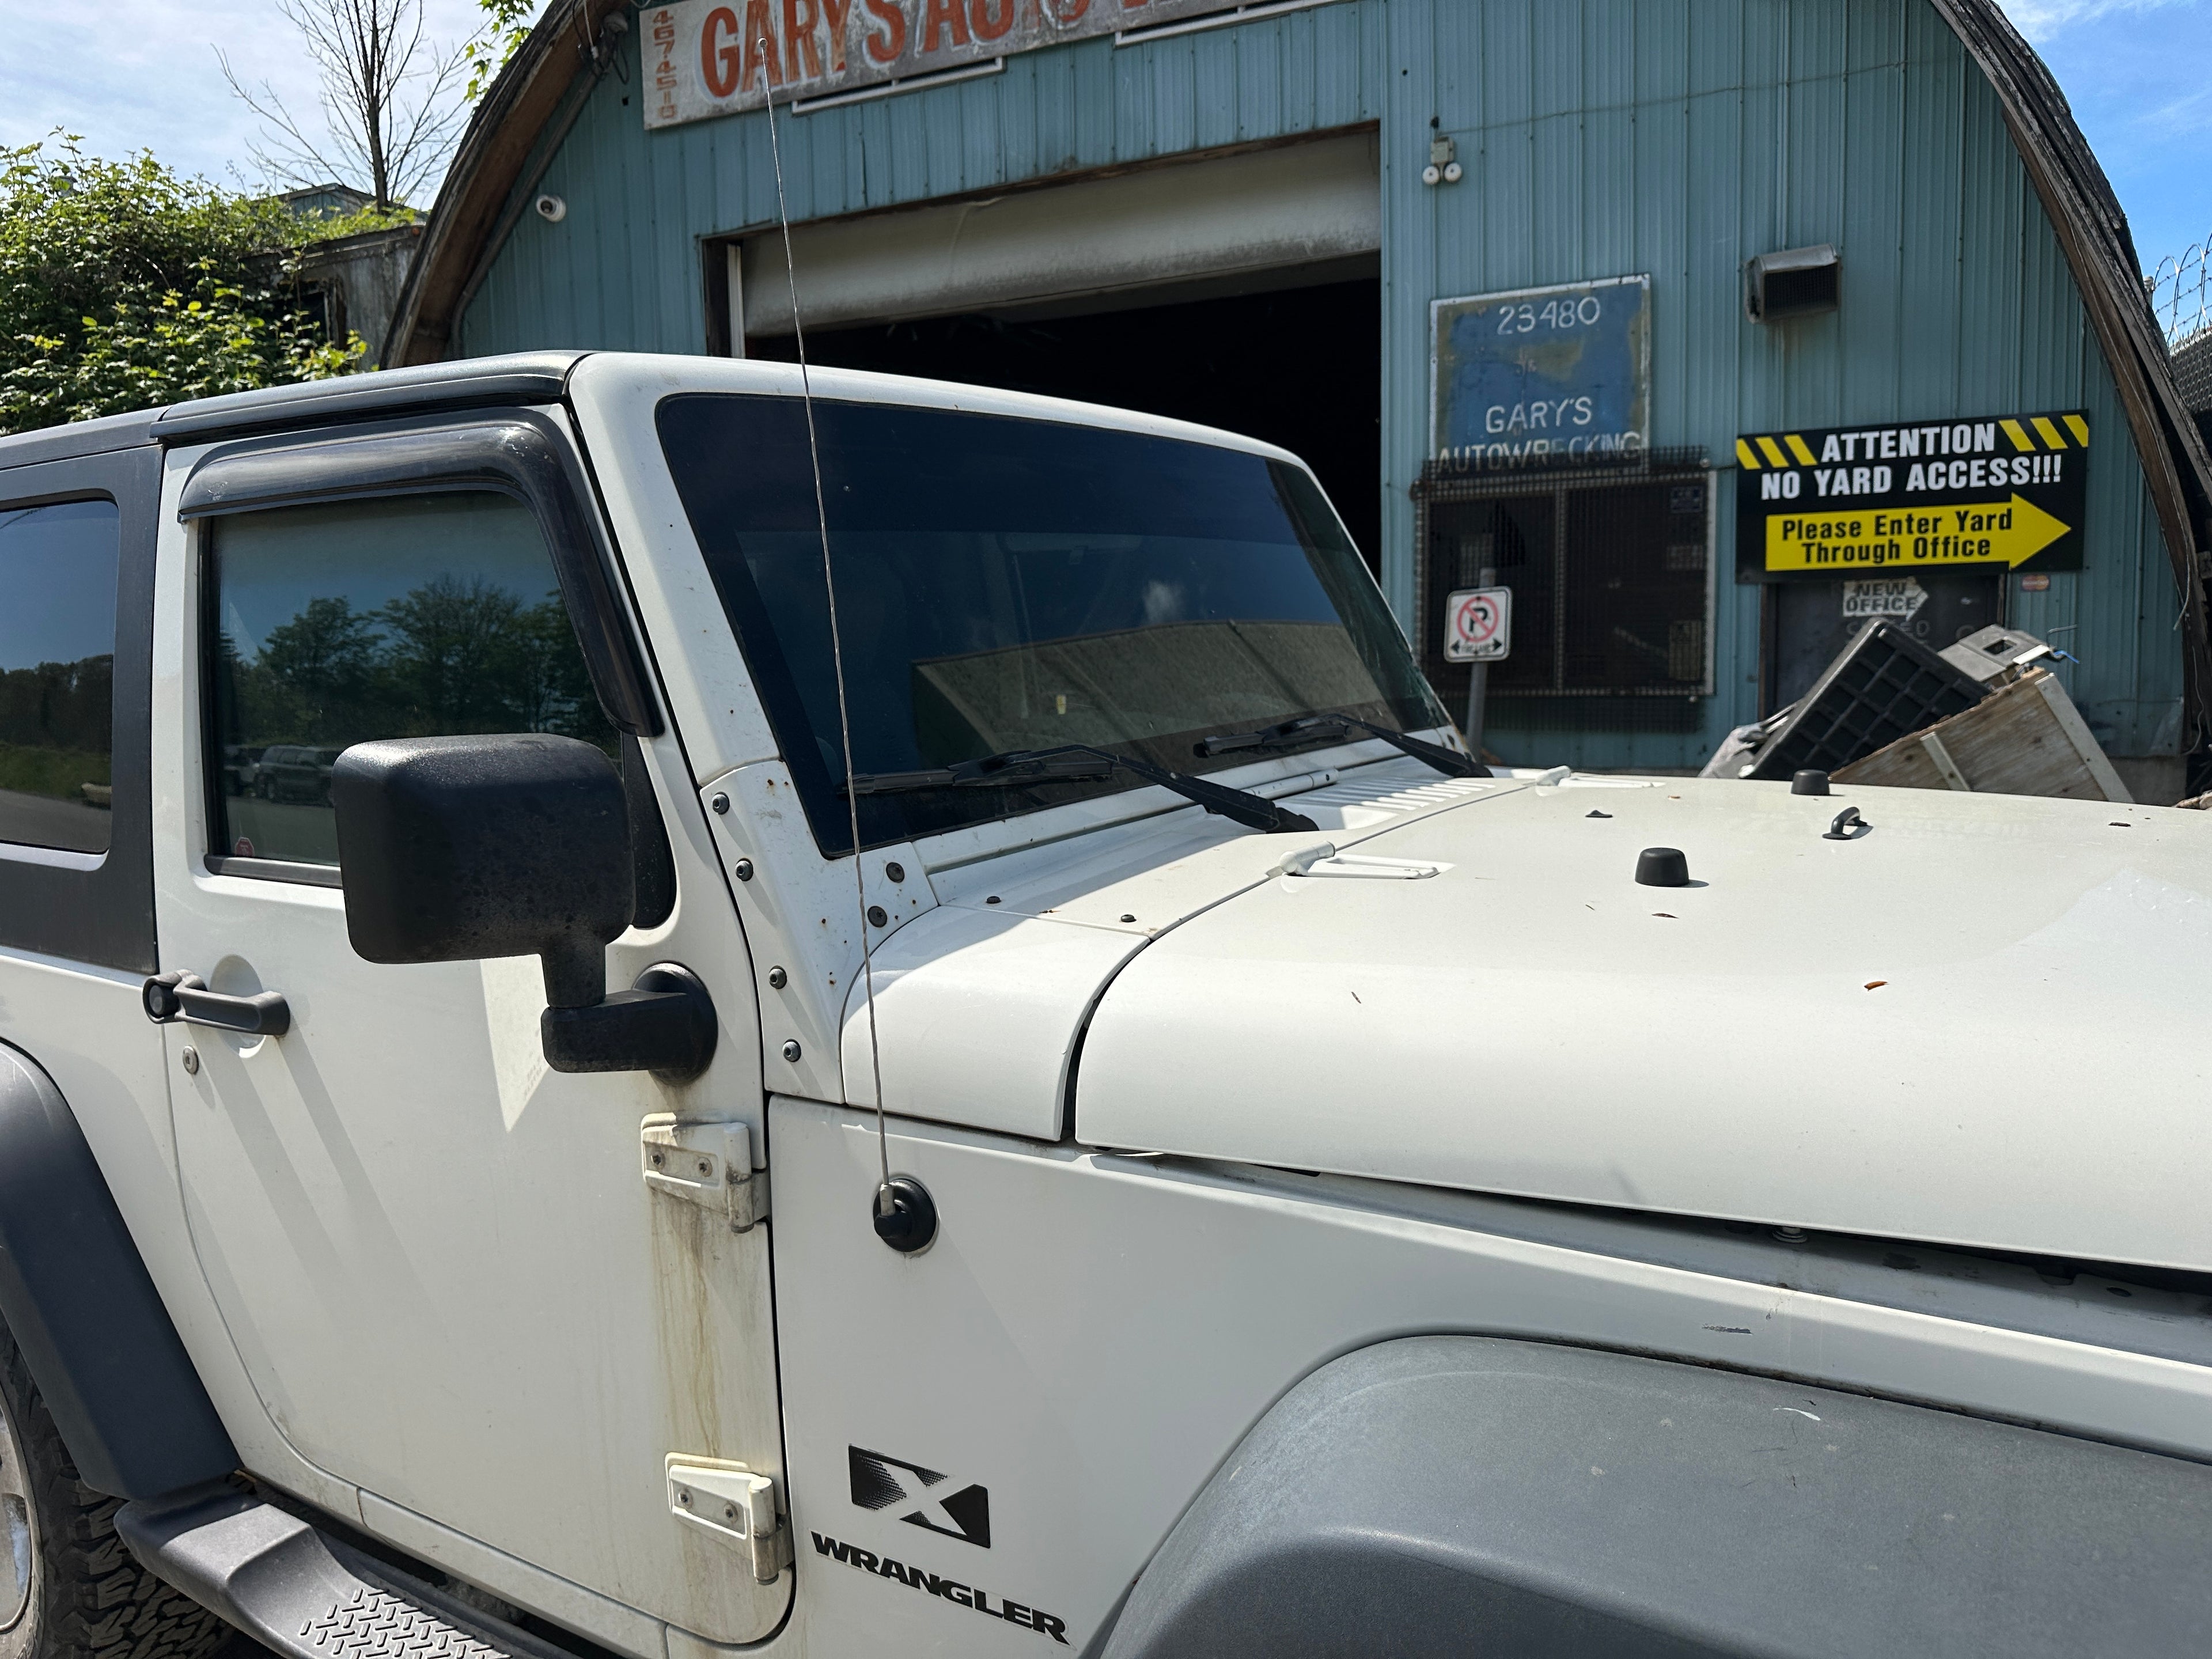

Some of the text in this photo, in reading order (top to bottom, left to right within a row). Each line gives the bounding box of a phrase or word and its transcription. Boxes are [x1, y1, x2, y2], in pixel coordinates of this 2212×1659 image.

[1498, 296, 1601, 335] 23480
[1486, 396, 1593, 434] GARY'S
[1820, 423, 1995, 463] ATTENTION
[1761, 454, 2062, 501] NO YARD ACCESS!!!
[1782, 508, 2012, 541] Please Enter Yard
[1802, 535, 1991, 565] Through Office
[1846, 596, 1919, 612] OFFICE
[1855, 582, 1906, 597] NEW
[810, 1530, 1070, 1646] WRANGLER
